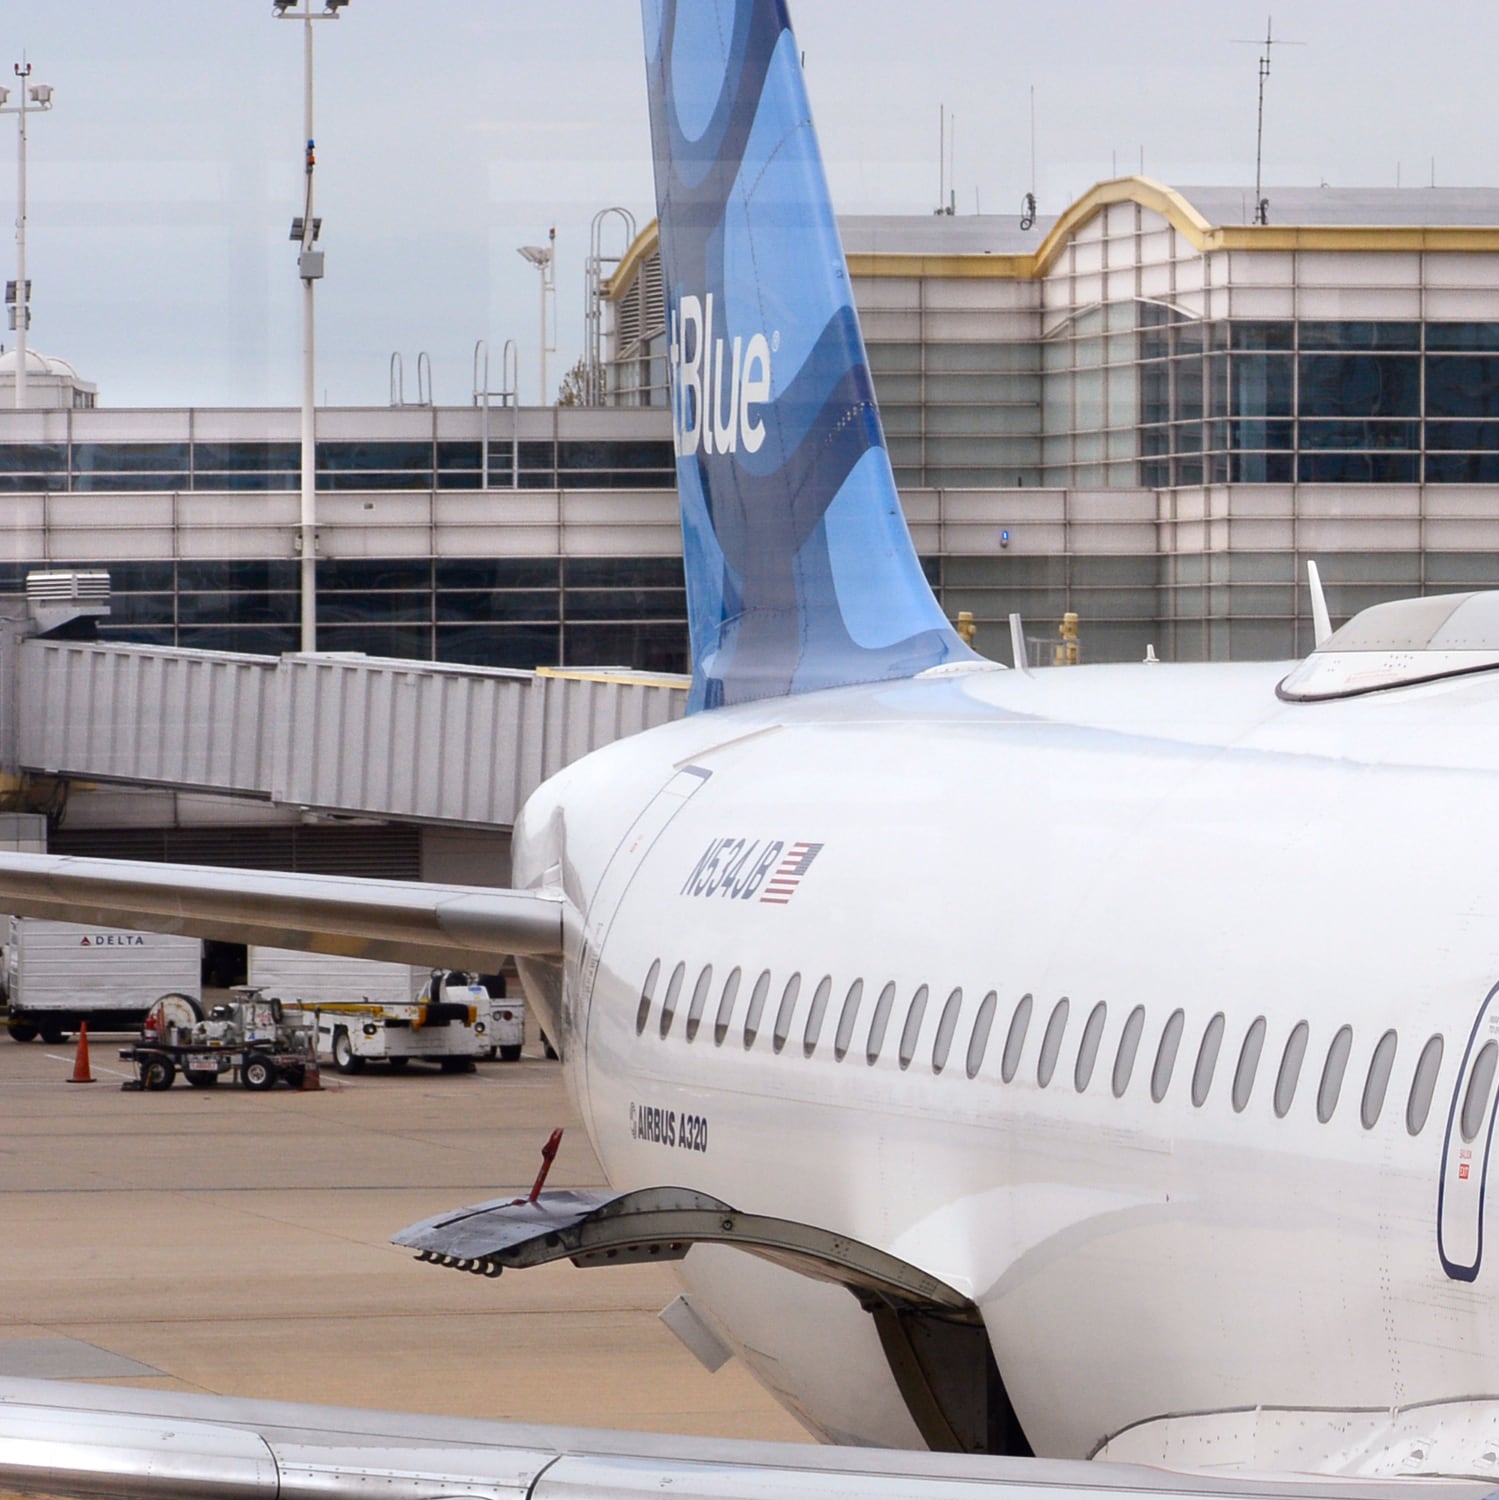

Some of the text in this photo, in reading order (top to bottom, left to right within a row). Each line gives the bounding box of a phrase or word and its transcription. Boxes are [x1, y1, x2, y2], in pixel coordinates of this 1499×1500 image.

[680, 838, 784, 899] N534JB
[95, 935, 144, 945] DELTA
[638, 1105, 675, 1147] AIRBUS
[678, 1112, 708, 1153] A320
